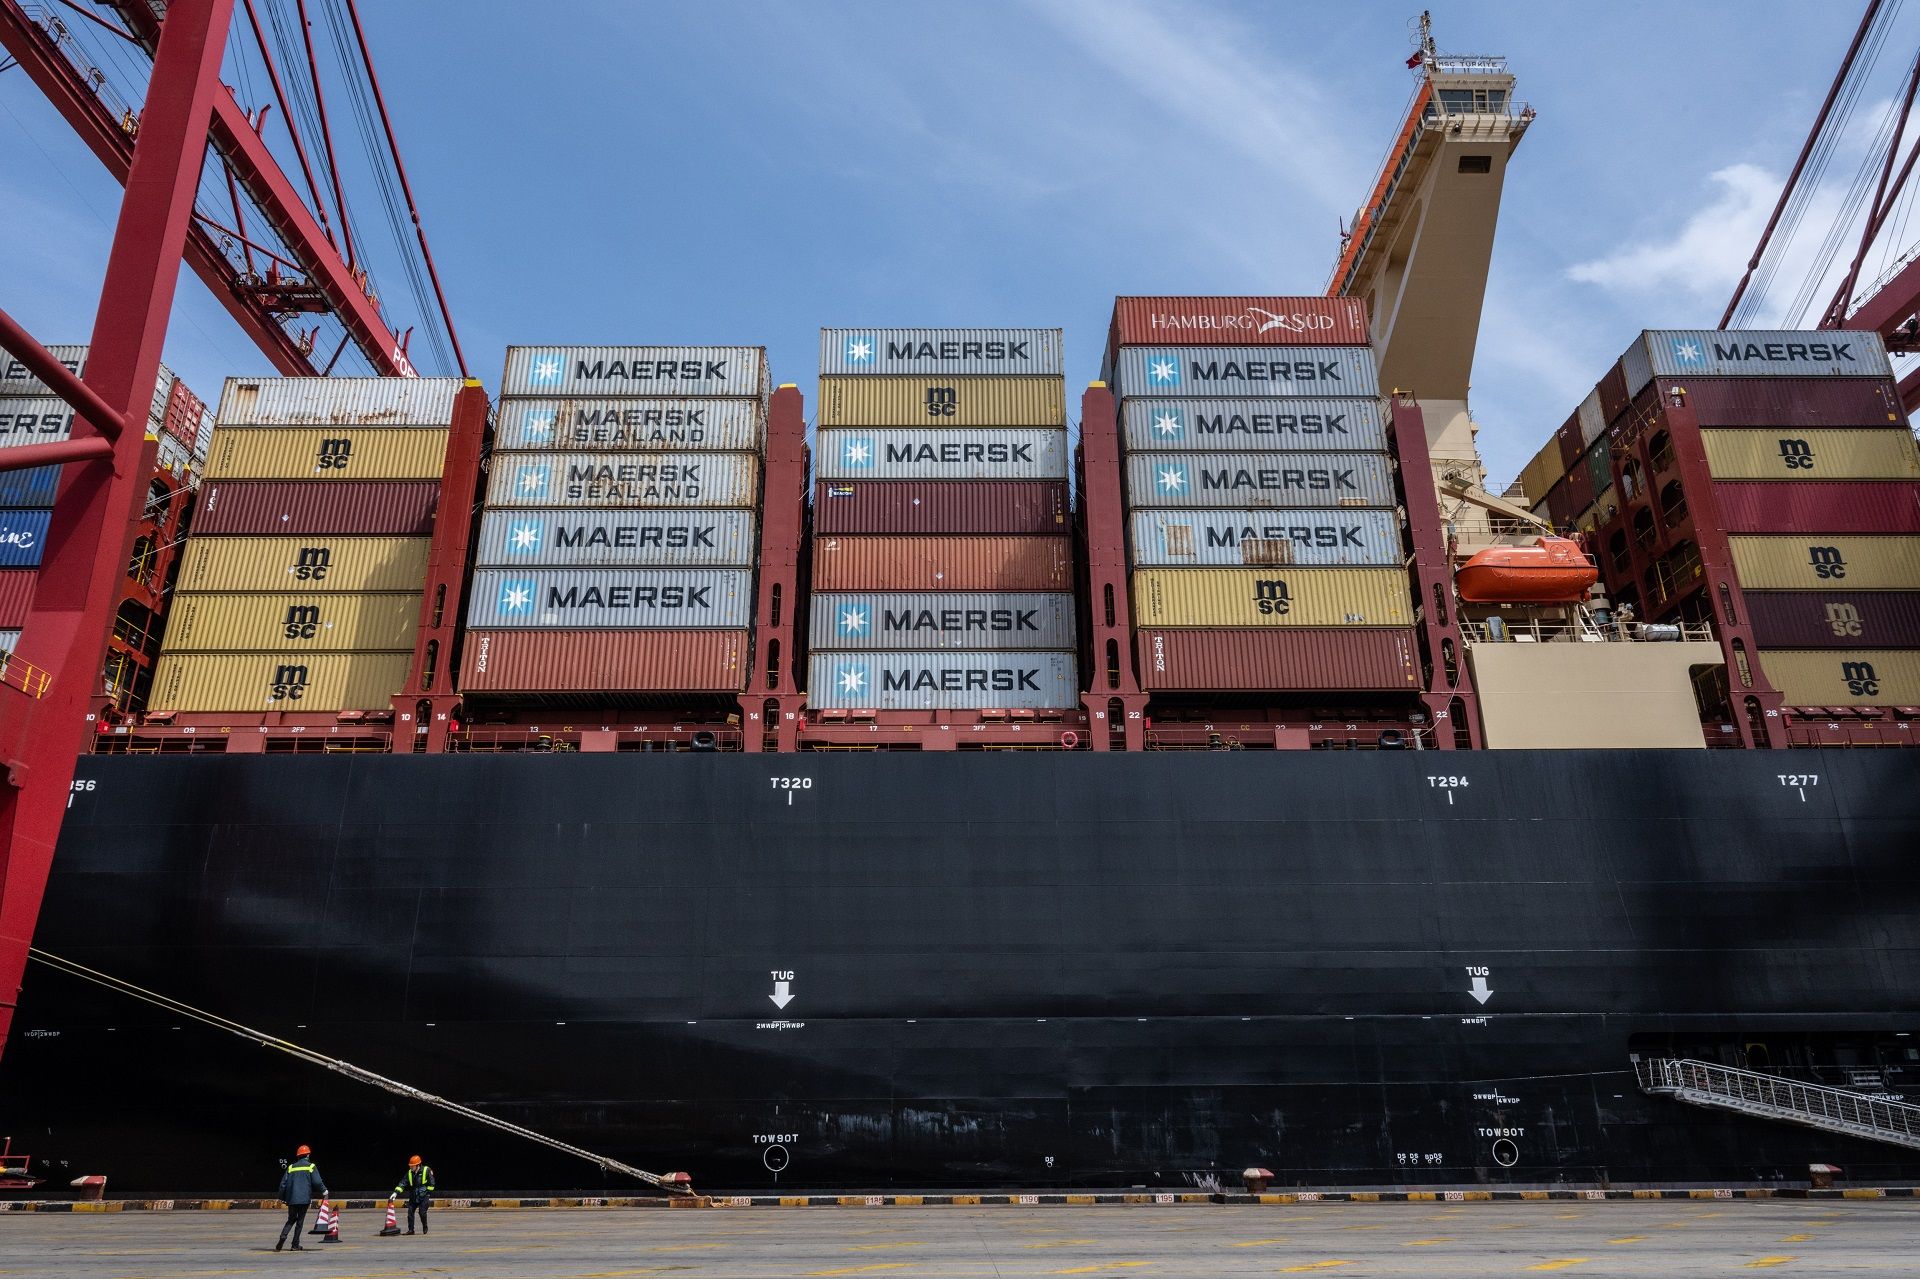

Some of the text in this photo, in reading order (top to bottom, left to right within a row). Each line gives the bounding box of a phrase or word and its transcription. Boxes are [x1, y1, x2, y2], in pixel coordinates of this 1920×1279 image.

[1152, 313, 1251, 330] HAMBURG
[1291, 312, 1334, 330] SÜD
[889, 342, 1029, 360] MAERSK
[1714, 344, 1855, 361] MAERSK
[393, 346, 417, 378] POR
[576, 361, 728, 380] MAERSK
[1192, 361, 1341, 381] MAERSK
[576, 410, 704, 426] MAERSK
[1197, 414, 1348, 434] MAERSK
[575, 429, 704, 442] SEALAND
[887, 443, 1033, 463] MAERSK
[570, 465, 700, 482] MAERSK
[1202, 469, 1357, 490] MAERSK
[568, 485, 700, 499] SEALAND
[556, 526, 716, 548] MAERSK
[549, 586, 712, 608] MAERSK
[885, 610, 1039, 631] MAERSK
[477, 637, 490, 672] TRITON
[1154, 636, 1165, 672] TRITON
[883, 669, 1041, 691] MAERSK
[70, 780, 96, 791] 56
[771, 777, 812, 789] T320
[1427, 776, 1469, 787] T294
[1777, 775, 1818, 786] T277
[771, 970, 795, 980] TUG
[1466, 966, 1490, 976] TUG
[866, 1197, 884, 1205] 1185
[1156, 1194, 1174, 1202] 1195
[1445, 1192, 1463, 1200] 1205
